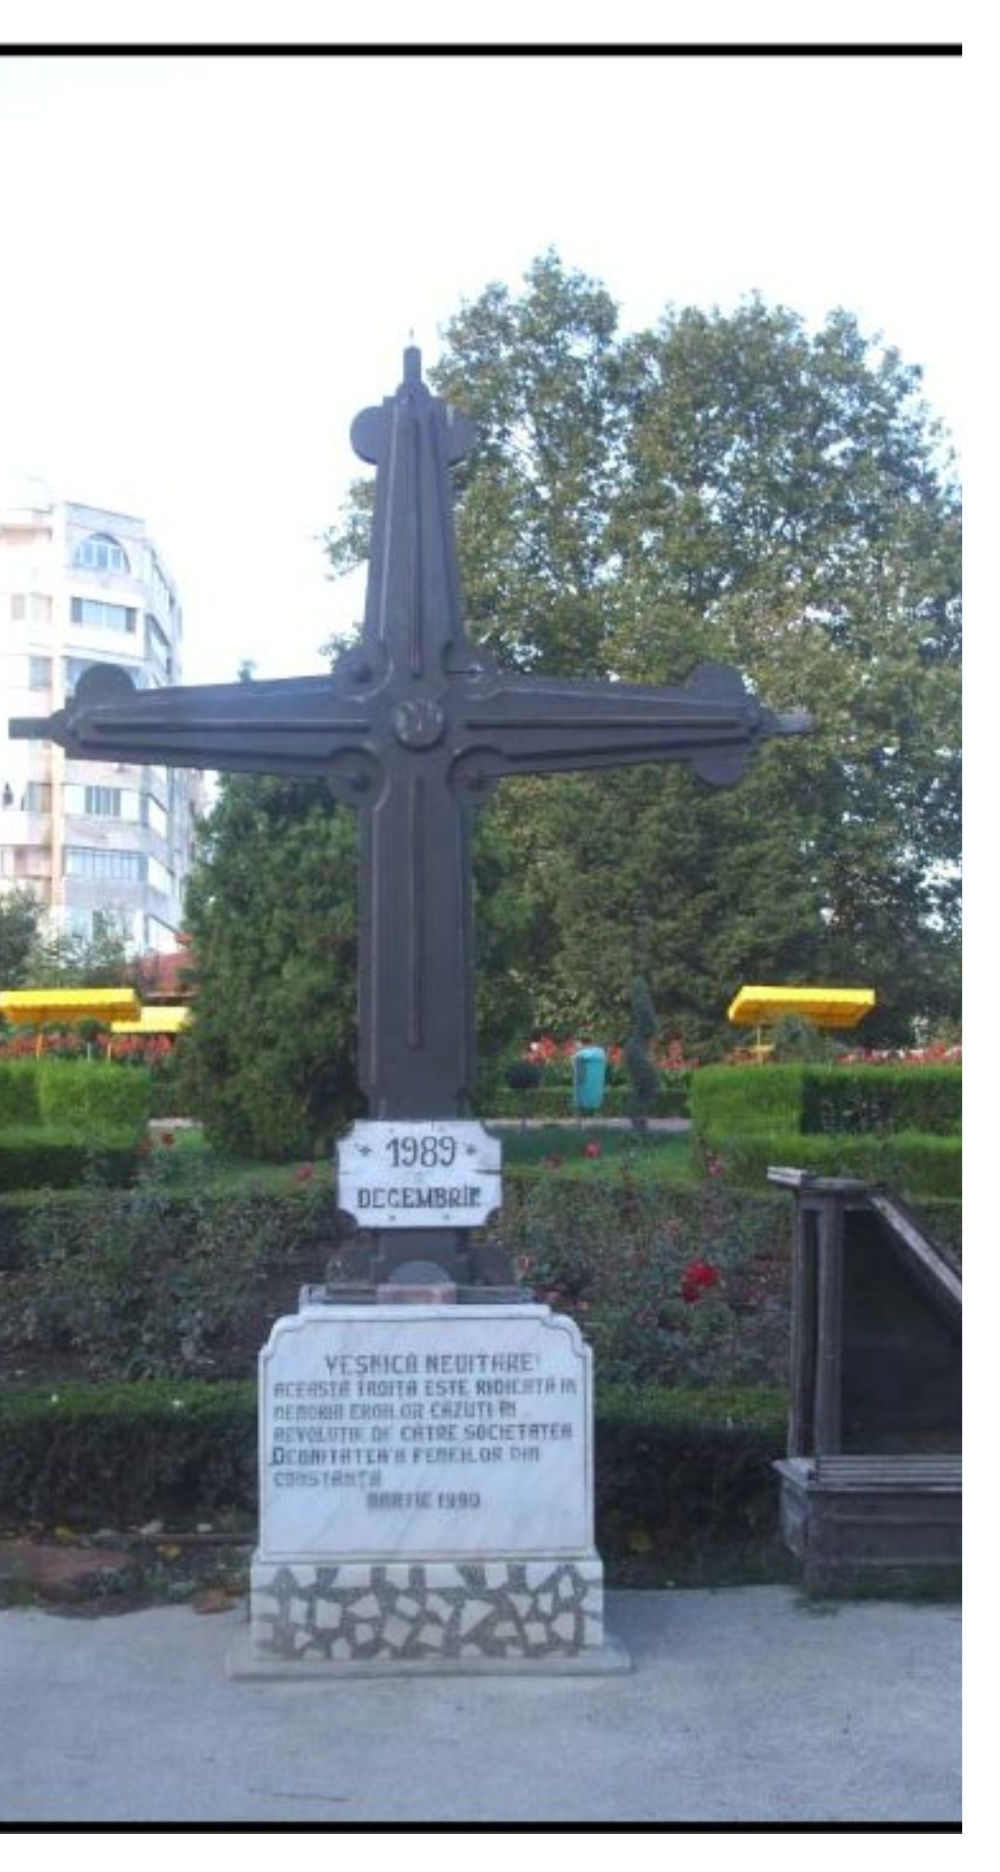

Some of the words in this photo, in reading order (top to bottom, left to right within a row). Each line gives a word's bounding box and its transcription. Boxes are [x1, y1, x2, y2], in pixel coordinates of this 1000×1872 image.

[385, 1136, 455, 1167] 1989
[358, 1185, 480, 1208] DECEMBRIE
[425, 1380, 468, 1396] ESTE
[464, 1423, 573, 1440] SOCIETATEA
